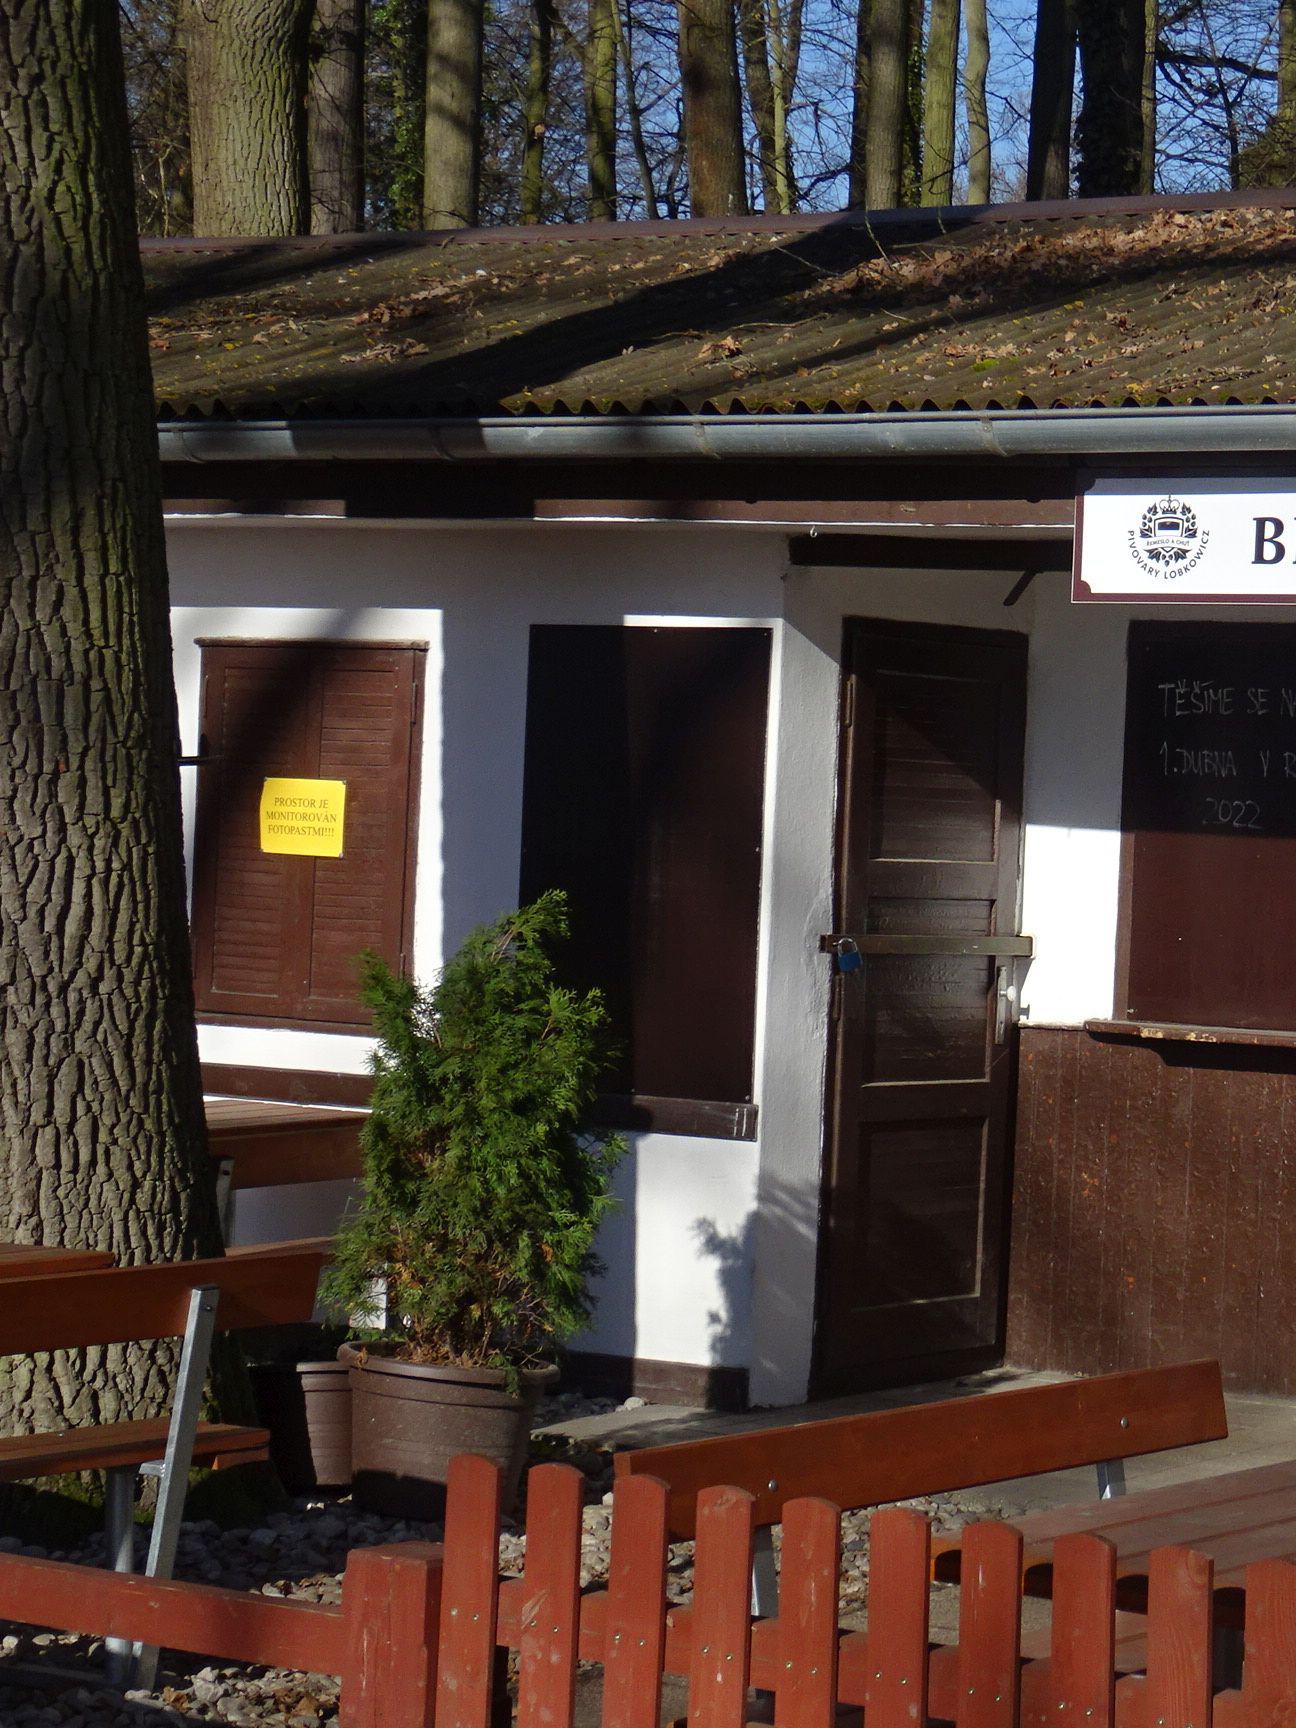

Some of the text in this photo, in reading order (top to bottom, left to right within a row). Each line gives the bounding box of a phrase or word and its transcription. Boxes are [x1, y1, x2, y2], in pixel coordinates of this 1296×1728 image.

[1127, 530, 1210, 580] PIVOVARY LOBKOWICZ
[1158, 679, 1236, 717] TĚŠÍME
[1247, 687, 1270, 716] SE
[274, 797, 329, 809] PROSTOR JE
[1202, 797, 1265, 829] 2022
[266, 810, 337, 823] MONITOROVÁN
[267, 824, 335, 837] FOTOPASTMI!!!
